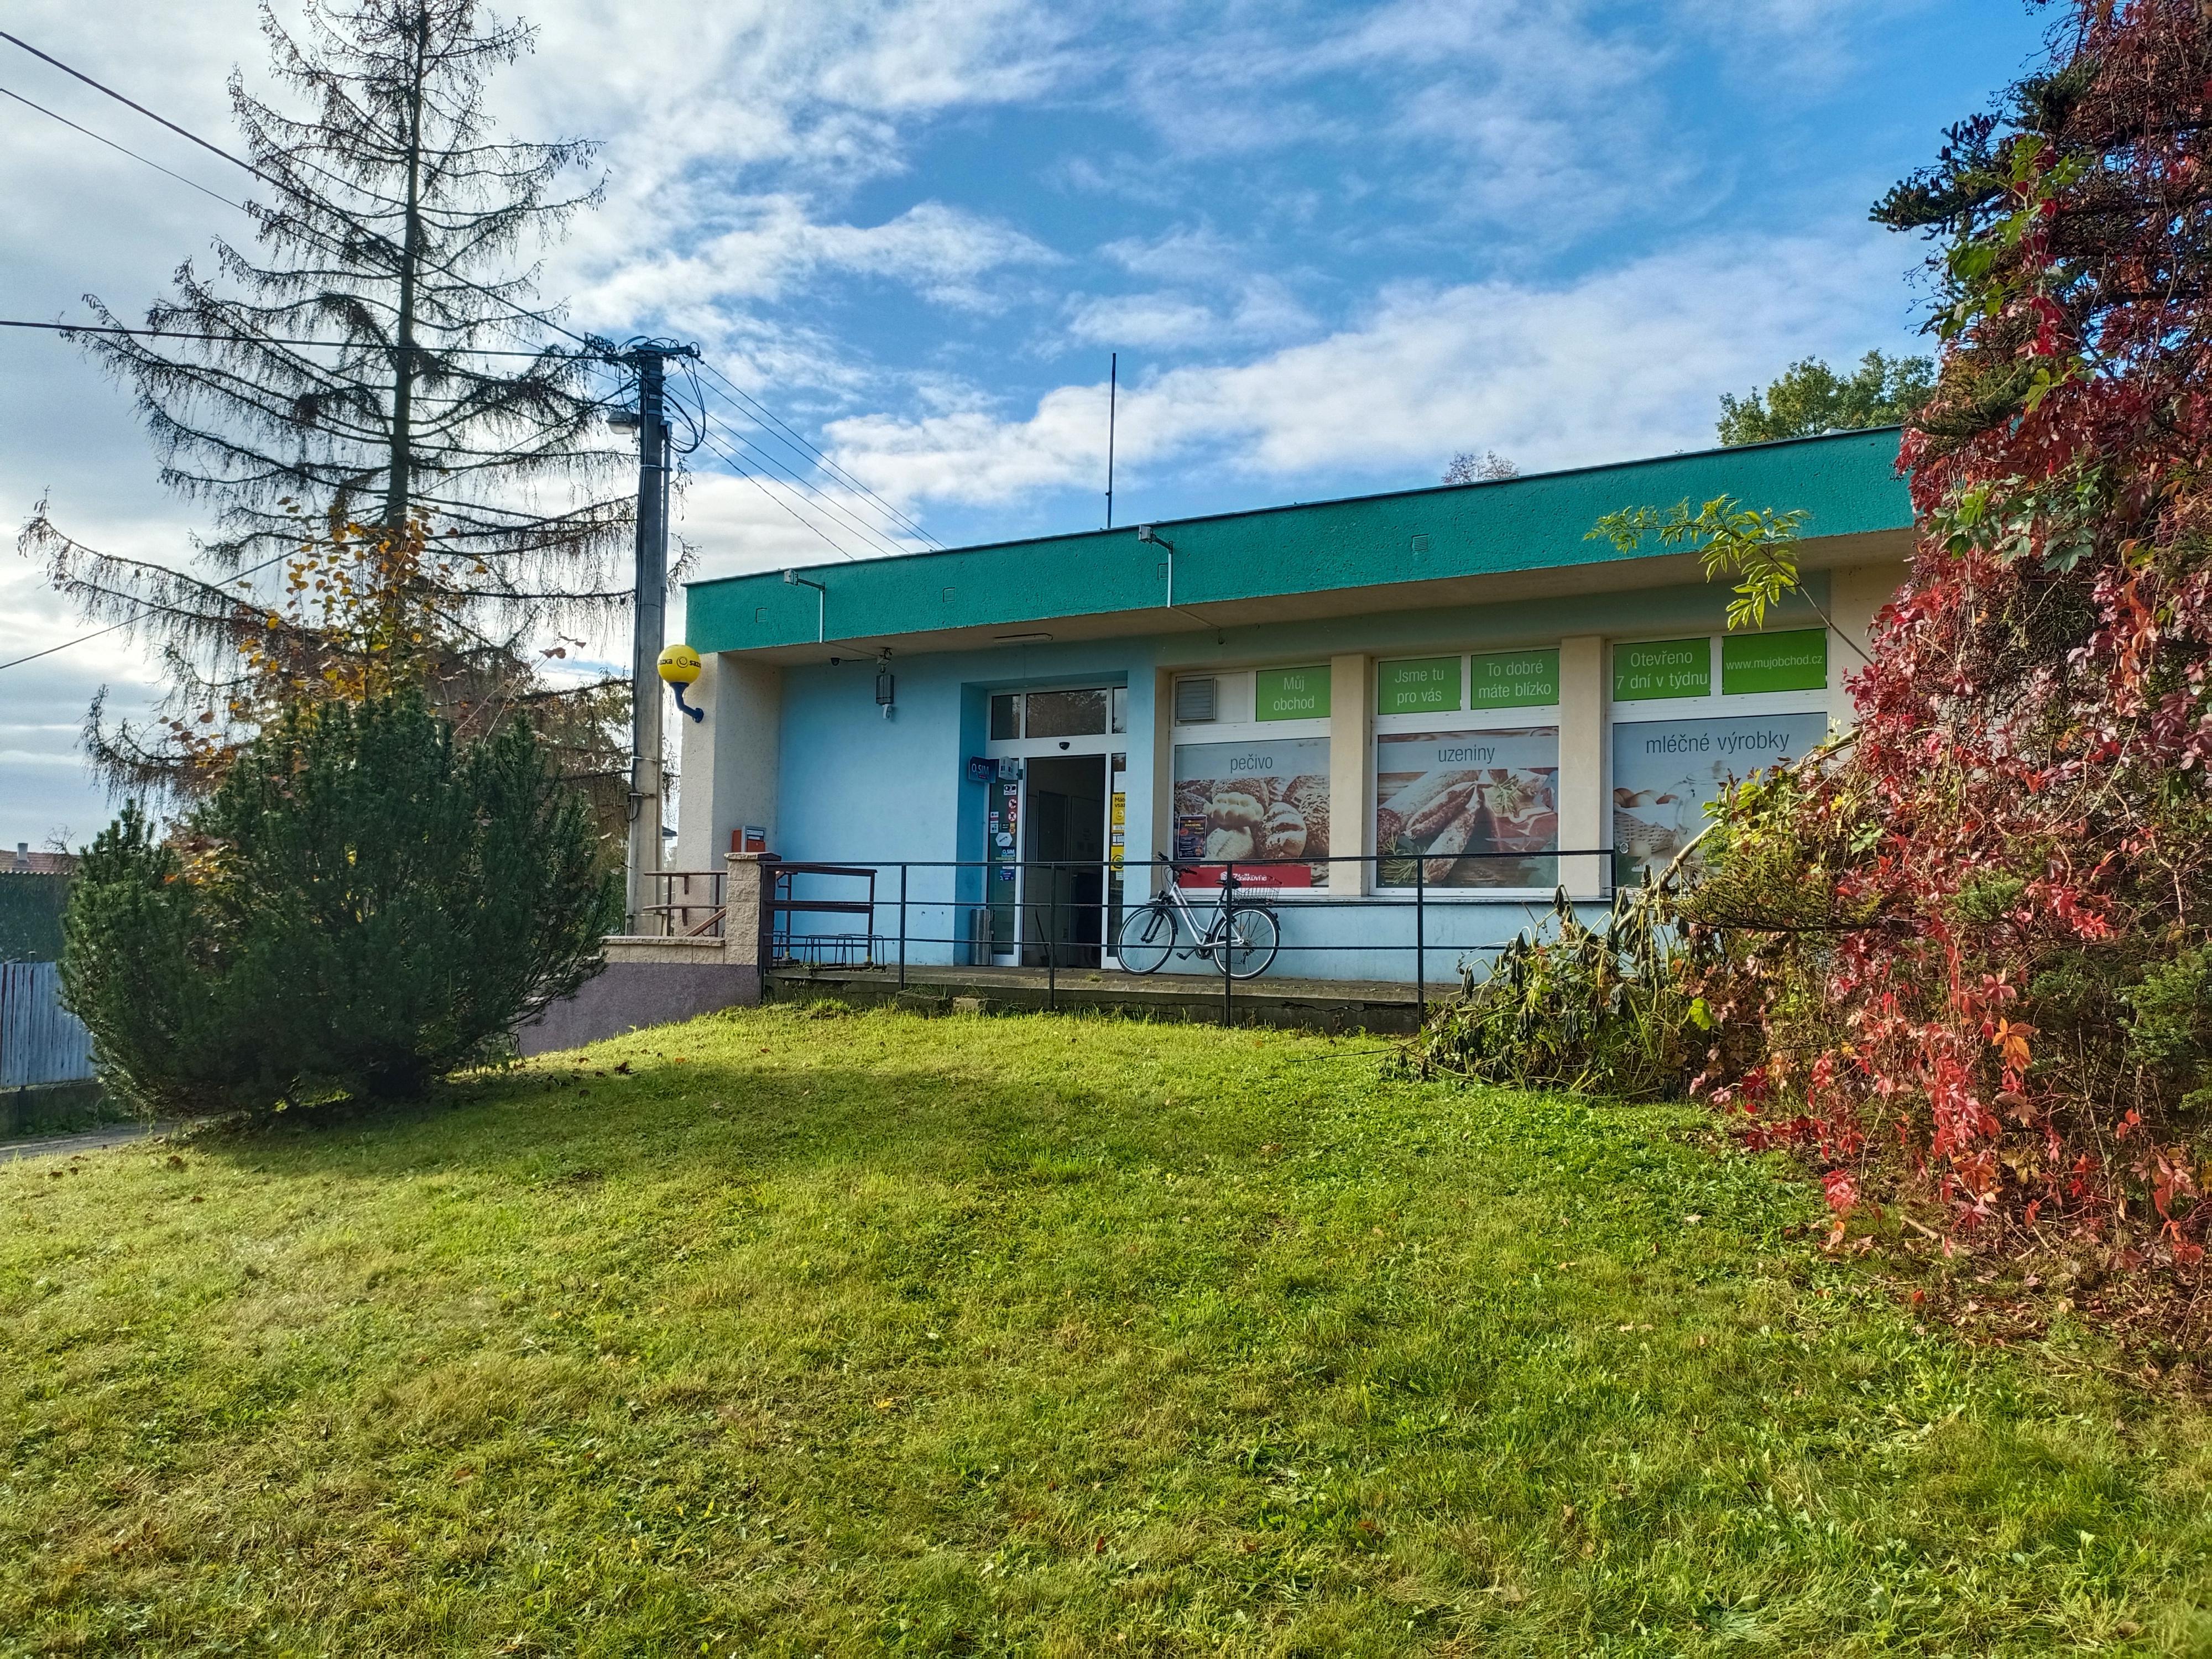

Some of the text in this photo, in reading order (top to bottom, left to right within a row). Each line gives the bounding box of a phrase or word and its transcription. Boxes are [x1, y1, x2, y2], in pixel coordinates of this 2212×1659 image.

[1486, 659, 1543, 676] To dobré
[1630, 651, 1693, 667] Otevřeno
[1725, 654, 1823, 670] www.mujobchod.cz
[1284, 675, 1305, 692] Můj
[1395, 668, 1444, 683] Jsme tu
[1616, 671, 1708, 690] 7 dní v týdnu
[1397, 688, 1442, 706] pro vás
[1479, 681, 1552, 698] máte blízko
[1274, 695, 1314, 711] obchod
[1646, 731, 1790, 754] mléčné výrobky
[1438, 744, 1495, 764] uzeniny
[978, 764, 989, 775] SIM
[1230, 753, 1273, 773] pečivo
